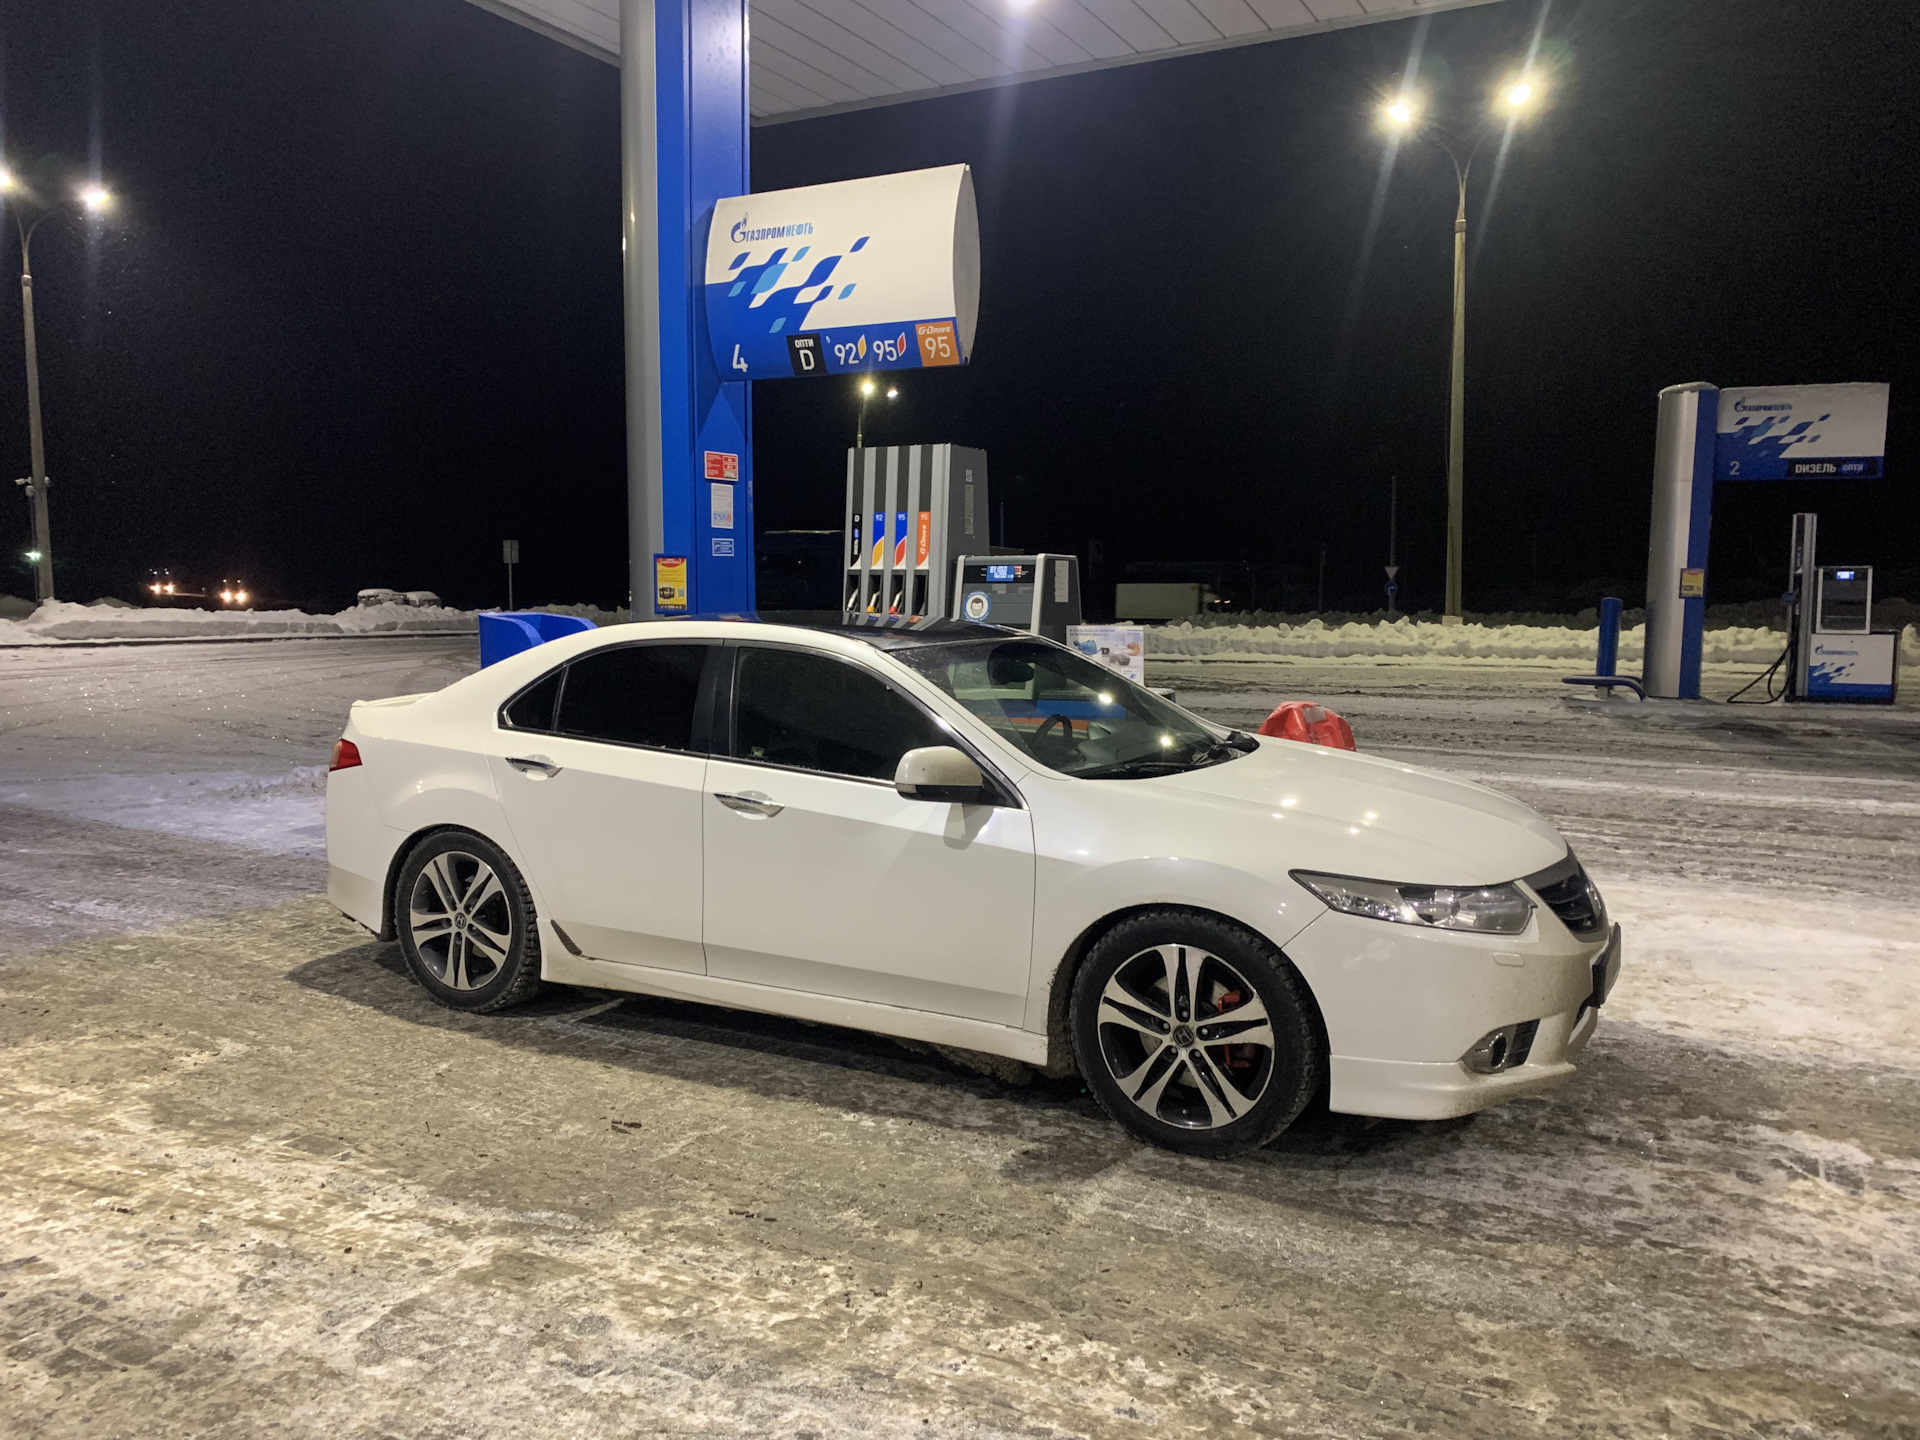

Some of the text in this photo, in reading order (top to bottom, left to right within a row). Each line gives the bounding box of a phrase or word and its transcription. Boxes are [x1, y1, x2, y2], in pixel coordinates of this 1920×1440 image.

[745, 222, 814, 242] ГАЗПРОМНЕФТЬ
[834, 340, 898, 366] 92 95
[925, 336, 951, 359] 95
[732, 344, 749, 373] 4
[801, 349, 816, 371] D
[1729, 460, 1740, 476] 2
[854, 514, 860, 523] D
[875, 514, 884, 522] 92
[897, 513, 906, 521] 95
[920, 513, 928, 521] 95
